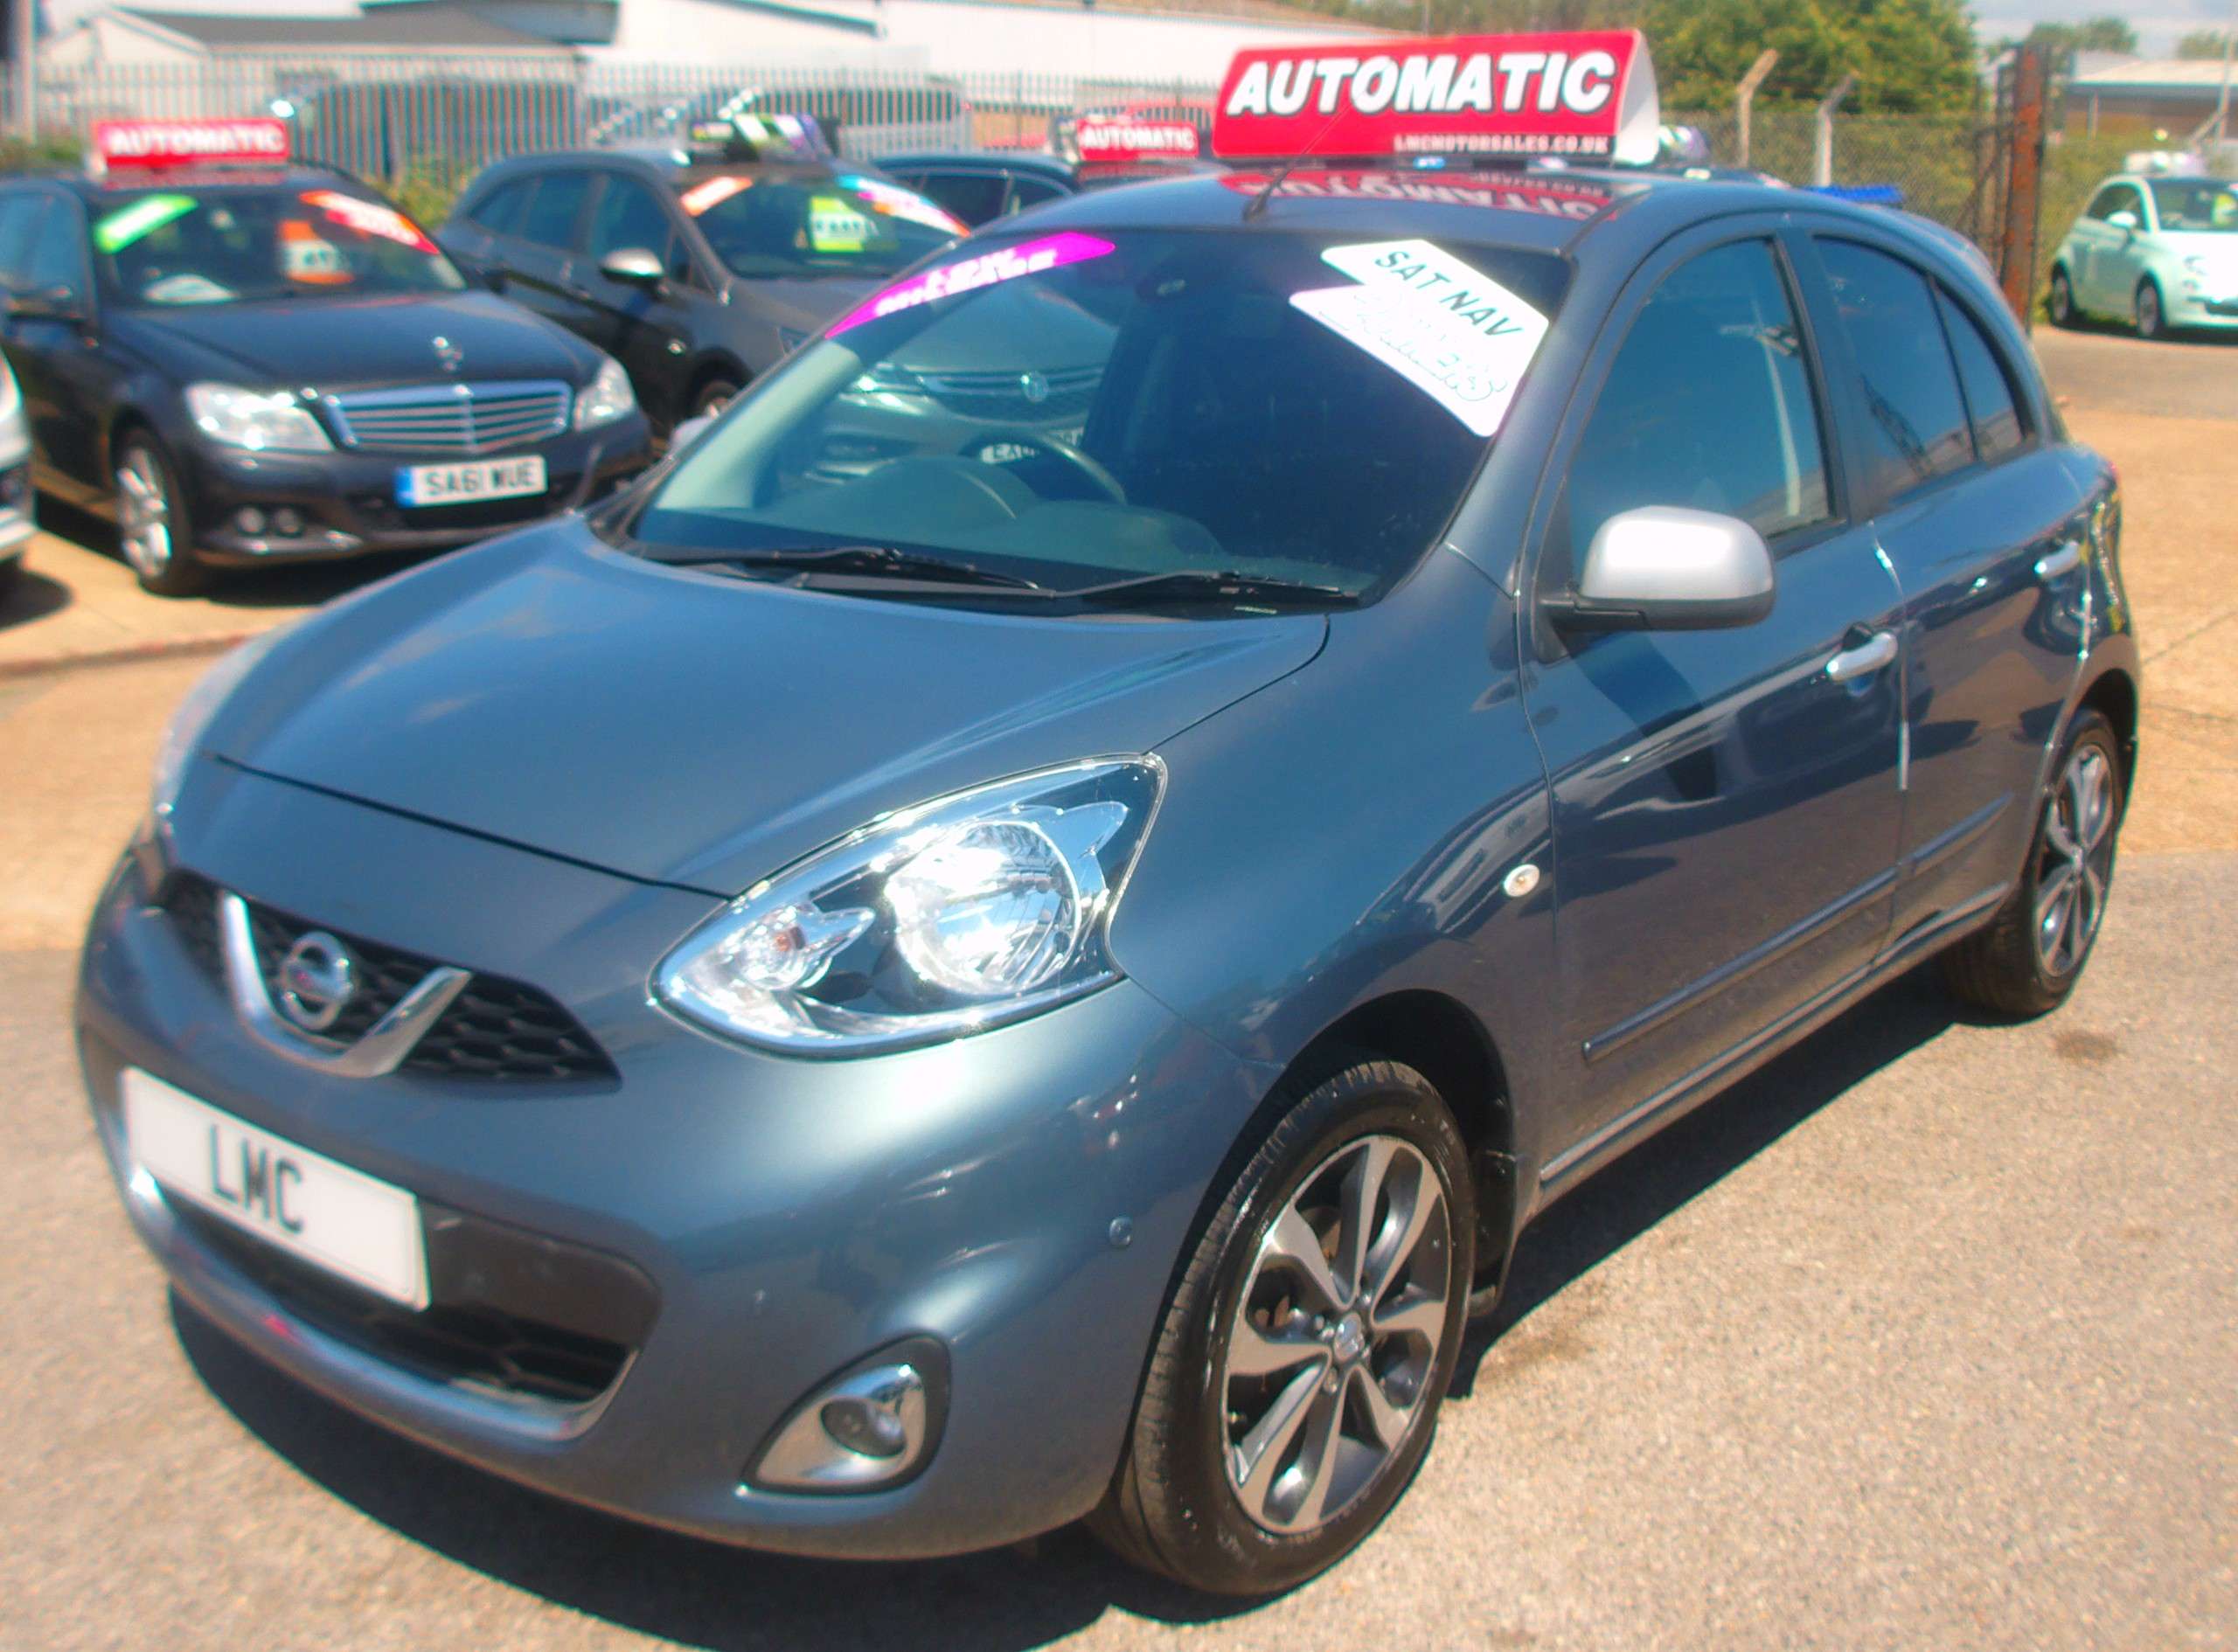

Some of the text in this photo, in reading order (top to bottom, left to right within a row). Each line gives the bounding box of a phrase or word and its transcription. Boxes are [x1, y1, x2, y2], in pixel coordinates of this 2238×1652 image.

[1226, 51, 1616, 115] AUTOMATIC
[107, 123, 287, 156] AUTOMATIC
[1081, 125, 1196, 151] AUTOMATIC
[1374, 250, 1524, 337] SAT NAV
[209, 1123, 304, 1236] LMC
